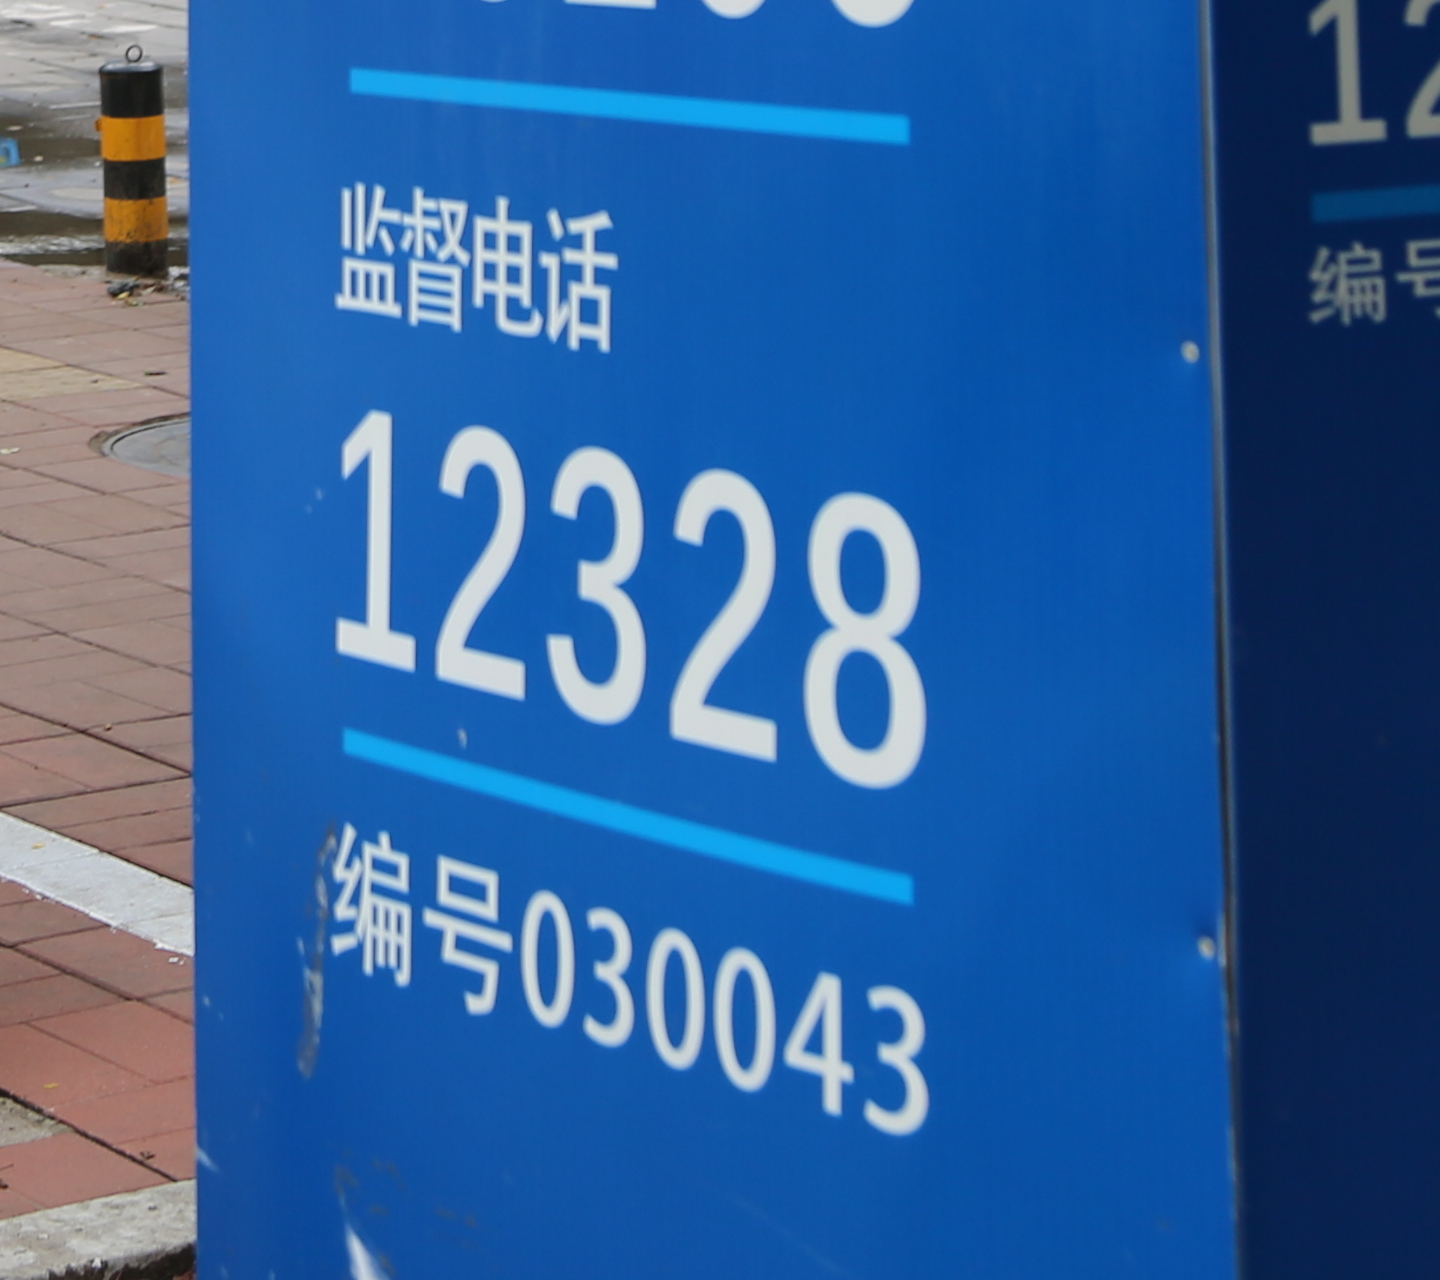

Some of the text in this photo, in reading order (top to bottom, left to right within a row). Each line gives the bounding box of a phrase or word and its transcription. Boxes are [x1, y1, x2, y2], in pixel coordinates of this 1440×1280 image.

[333, 181, 620, 353] 监督电话
[334, 407, 928, 791] 12328
[329, 821, 932, 1139] 编号030043
